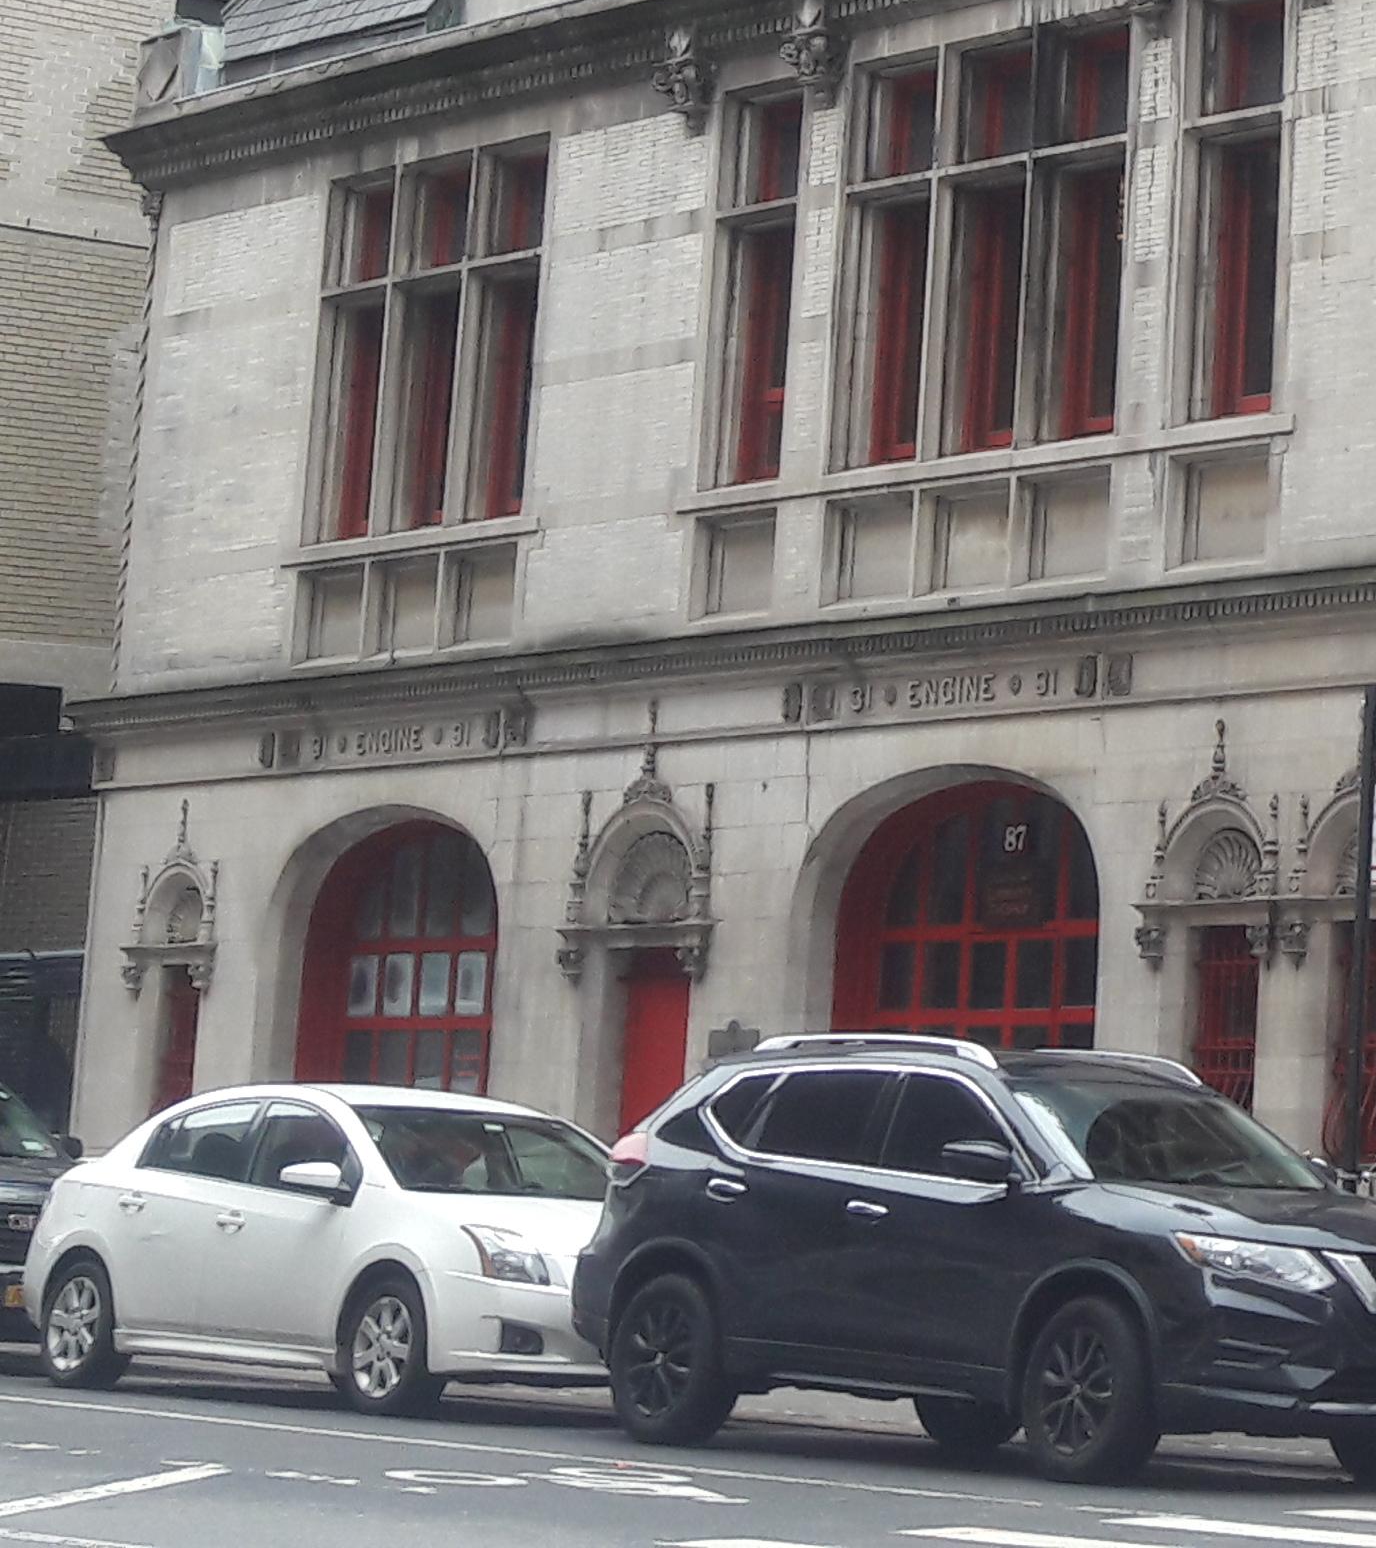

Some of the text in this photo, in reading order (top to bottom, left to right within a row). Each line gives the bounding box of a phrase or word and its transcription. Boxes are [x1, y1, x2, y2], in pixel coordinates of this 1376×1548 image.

[850, 669, 1059, 713] 31 ENGINE 31
[355, 724, 423, 755] ENGINE
[1004, 824, 1027, 852] 87
